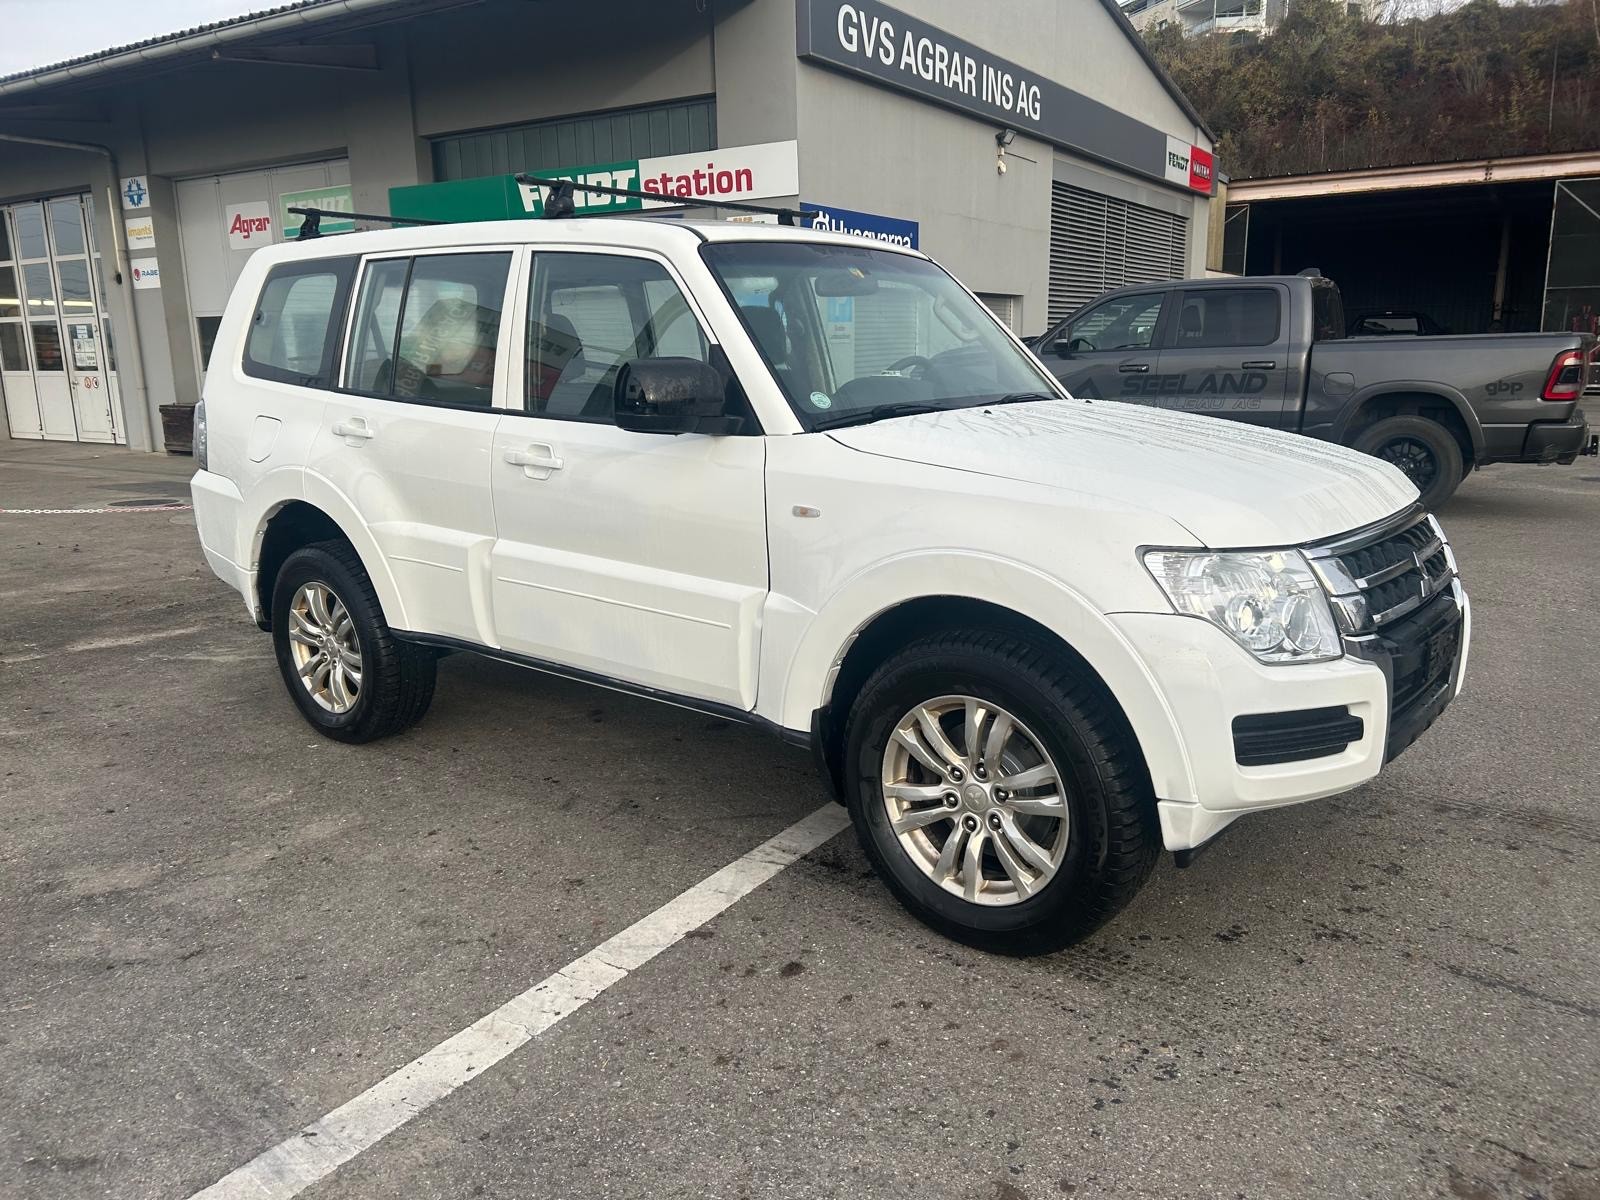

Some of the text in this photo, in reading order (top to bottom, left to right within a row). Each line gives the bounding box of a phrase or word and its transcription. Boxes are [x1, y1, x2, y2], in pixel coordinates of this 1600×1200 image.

[838, 4, 1041, 121] GVS AGRAR INS AG
[1168, 151, 1189, 171] FENDT
[643, 163, 753, 197] station
[230, 214, 270, 239] Agrar
[1120, 373, 1268, 395] SEELAND
[1485, 380, 1524, 396] gbp
